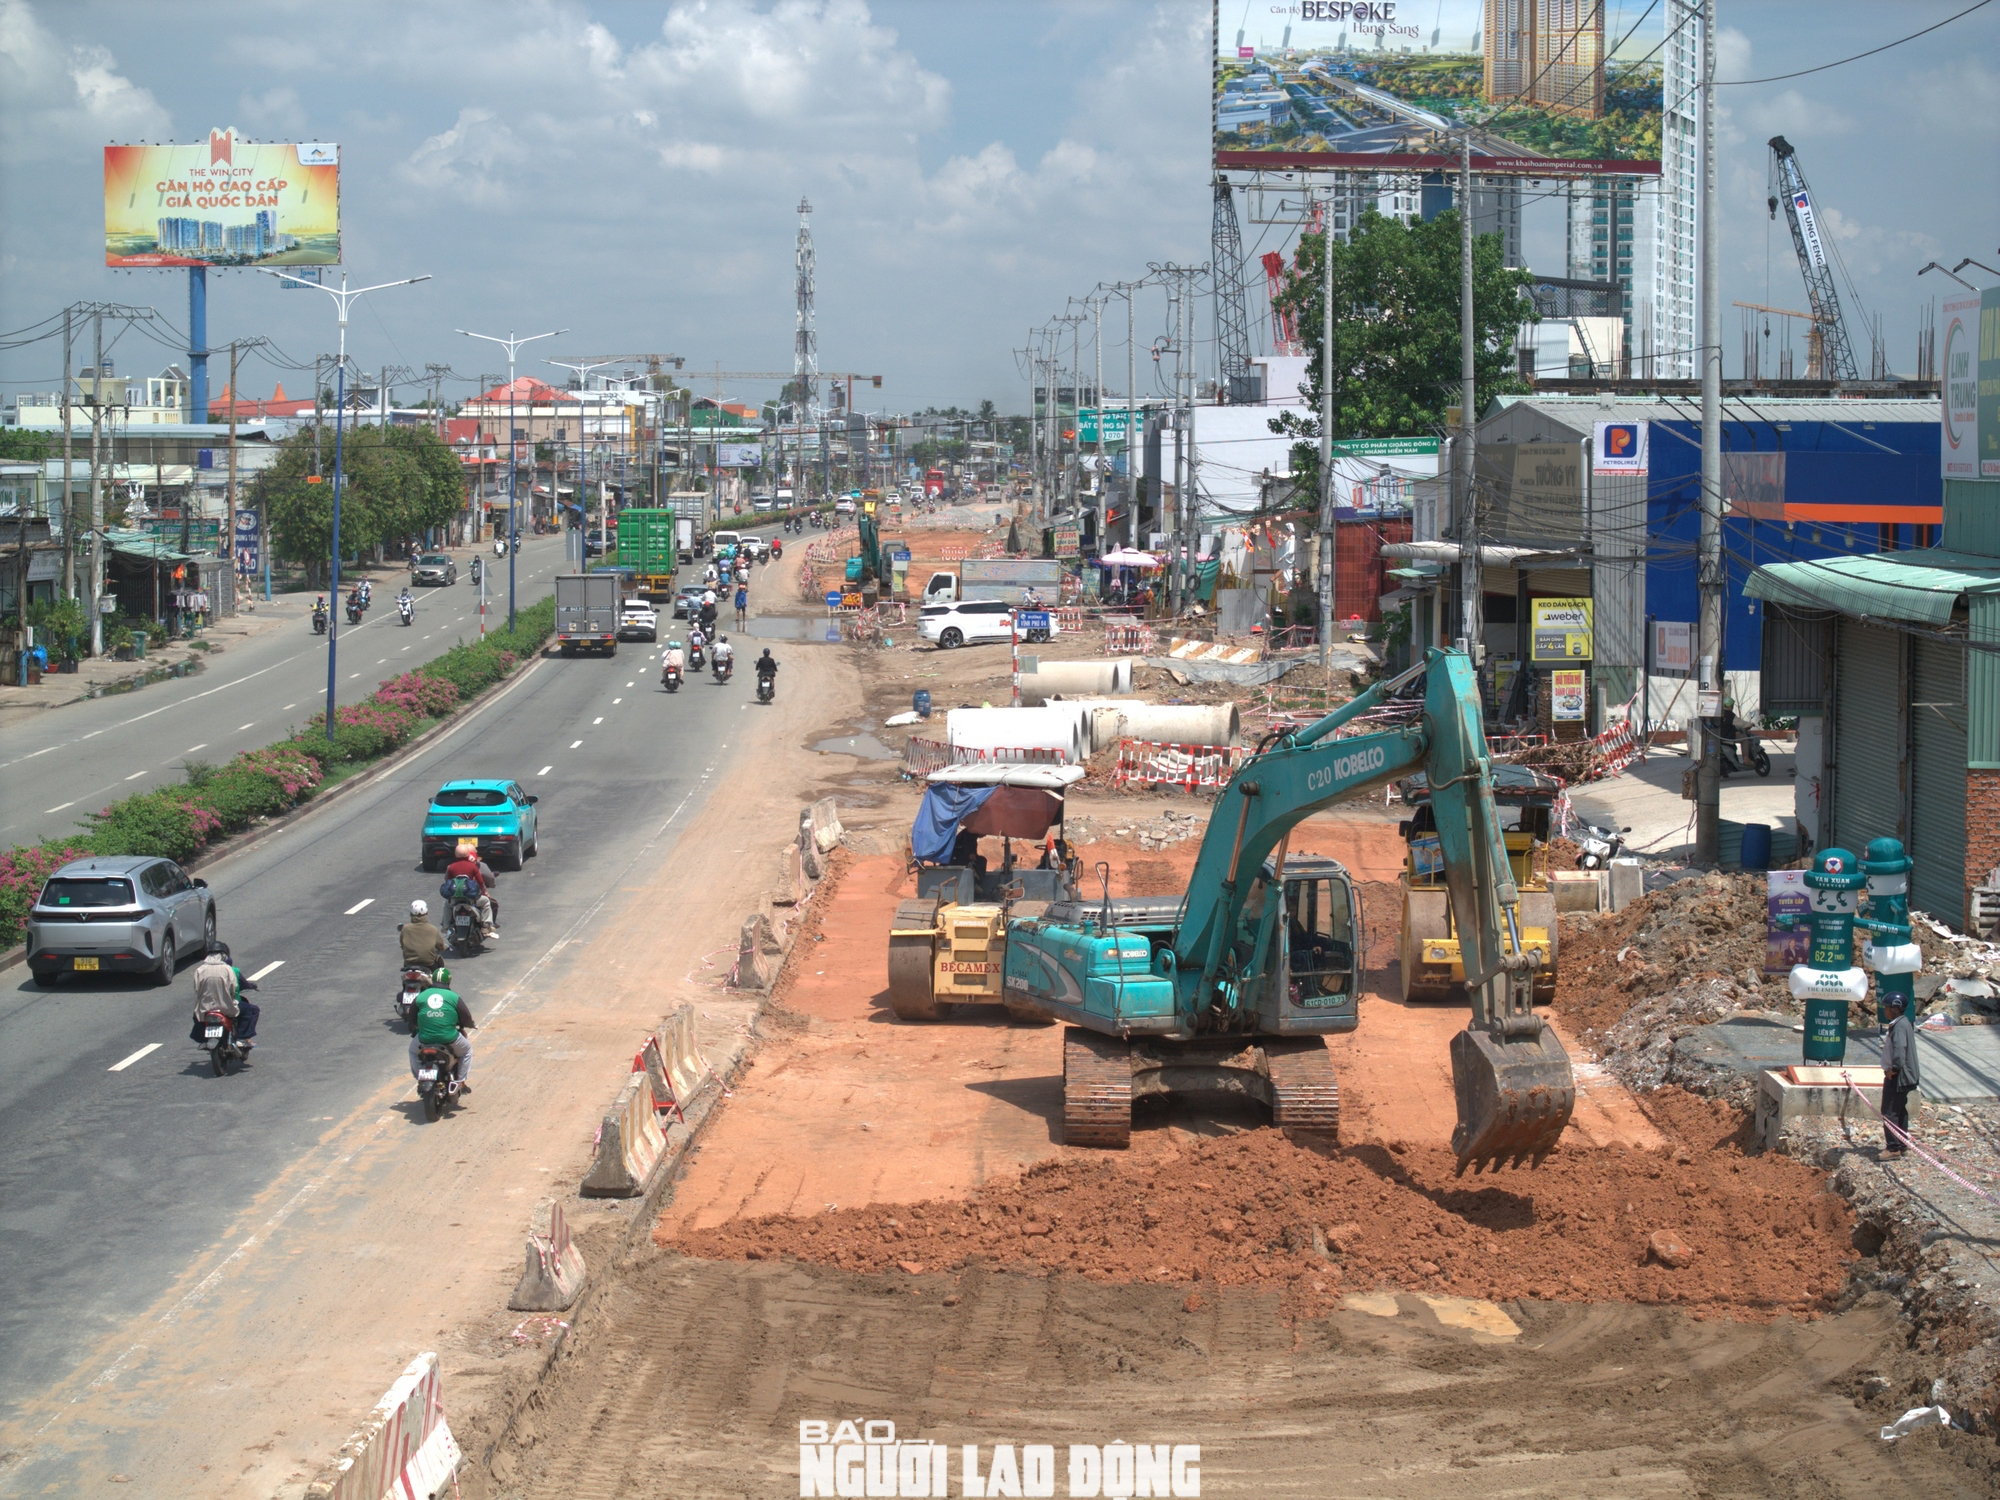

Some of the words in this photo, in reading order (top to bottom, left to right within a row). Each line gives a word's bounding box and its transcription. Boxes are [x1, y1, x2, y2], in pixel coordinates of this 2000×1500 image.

[1270, 5, 1286, 14] Căn
[1289, 6, 1301, 15] Hộ
[1301, 0, 1396, 21] BESPOKE
[1353, 22, 1385, 37] Hạng
[1388, 23, 1420, 38] Sang
[189, 168, 206, 176] THE
[209, 168, 228, 176] WIN
[230, 168, 254, 177] CITY
[156, 178, 188, 193] CĂN
[192, 178, 215, 195] HỘ
[219, 181, 251, 192] CAO
[256, 177, 288, 192] CẤP
[166, 192, 193, 207] GIÁ
[196, 193, 241, 209] QUỐC
[245, 193, 278, 207] DÂN
[1803, 210, 1816, 238] TUNG
[1810, 239, 1824, 265] FENG
[1950, 351, 1969, 379] LINH
[1950, 380, 1976, 409] TRUNG
[1079, 420, 1092, 429] BẤT
[1370, 441, 1388, 449] PHẦN
[1553, 600, 1567, 608] DÁN
[1551, 611, 1583, 621] weber
[1020, 619, 1031, 627] VĨNH
[1031, 618, 1040, 627] PHÚ
[1548, 642, 1554, 650] 4
[1333, 746, 1385, 781] KOBELCO
[1122, 950, 1148, 958] KOBELCO
[1815, 950, 1834, 963] 62.2
[940, 962, 1001, 973] BECAMEX
[1006, 975, 1029, 991] SK200
[1818, 1009, 1828, 1017] CĂN
[1829, 1009, 1836, 1018] HỘ
[1818, 1028, 1828, 1036] LIÊN
